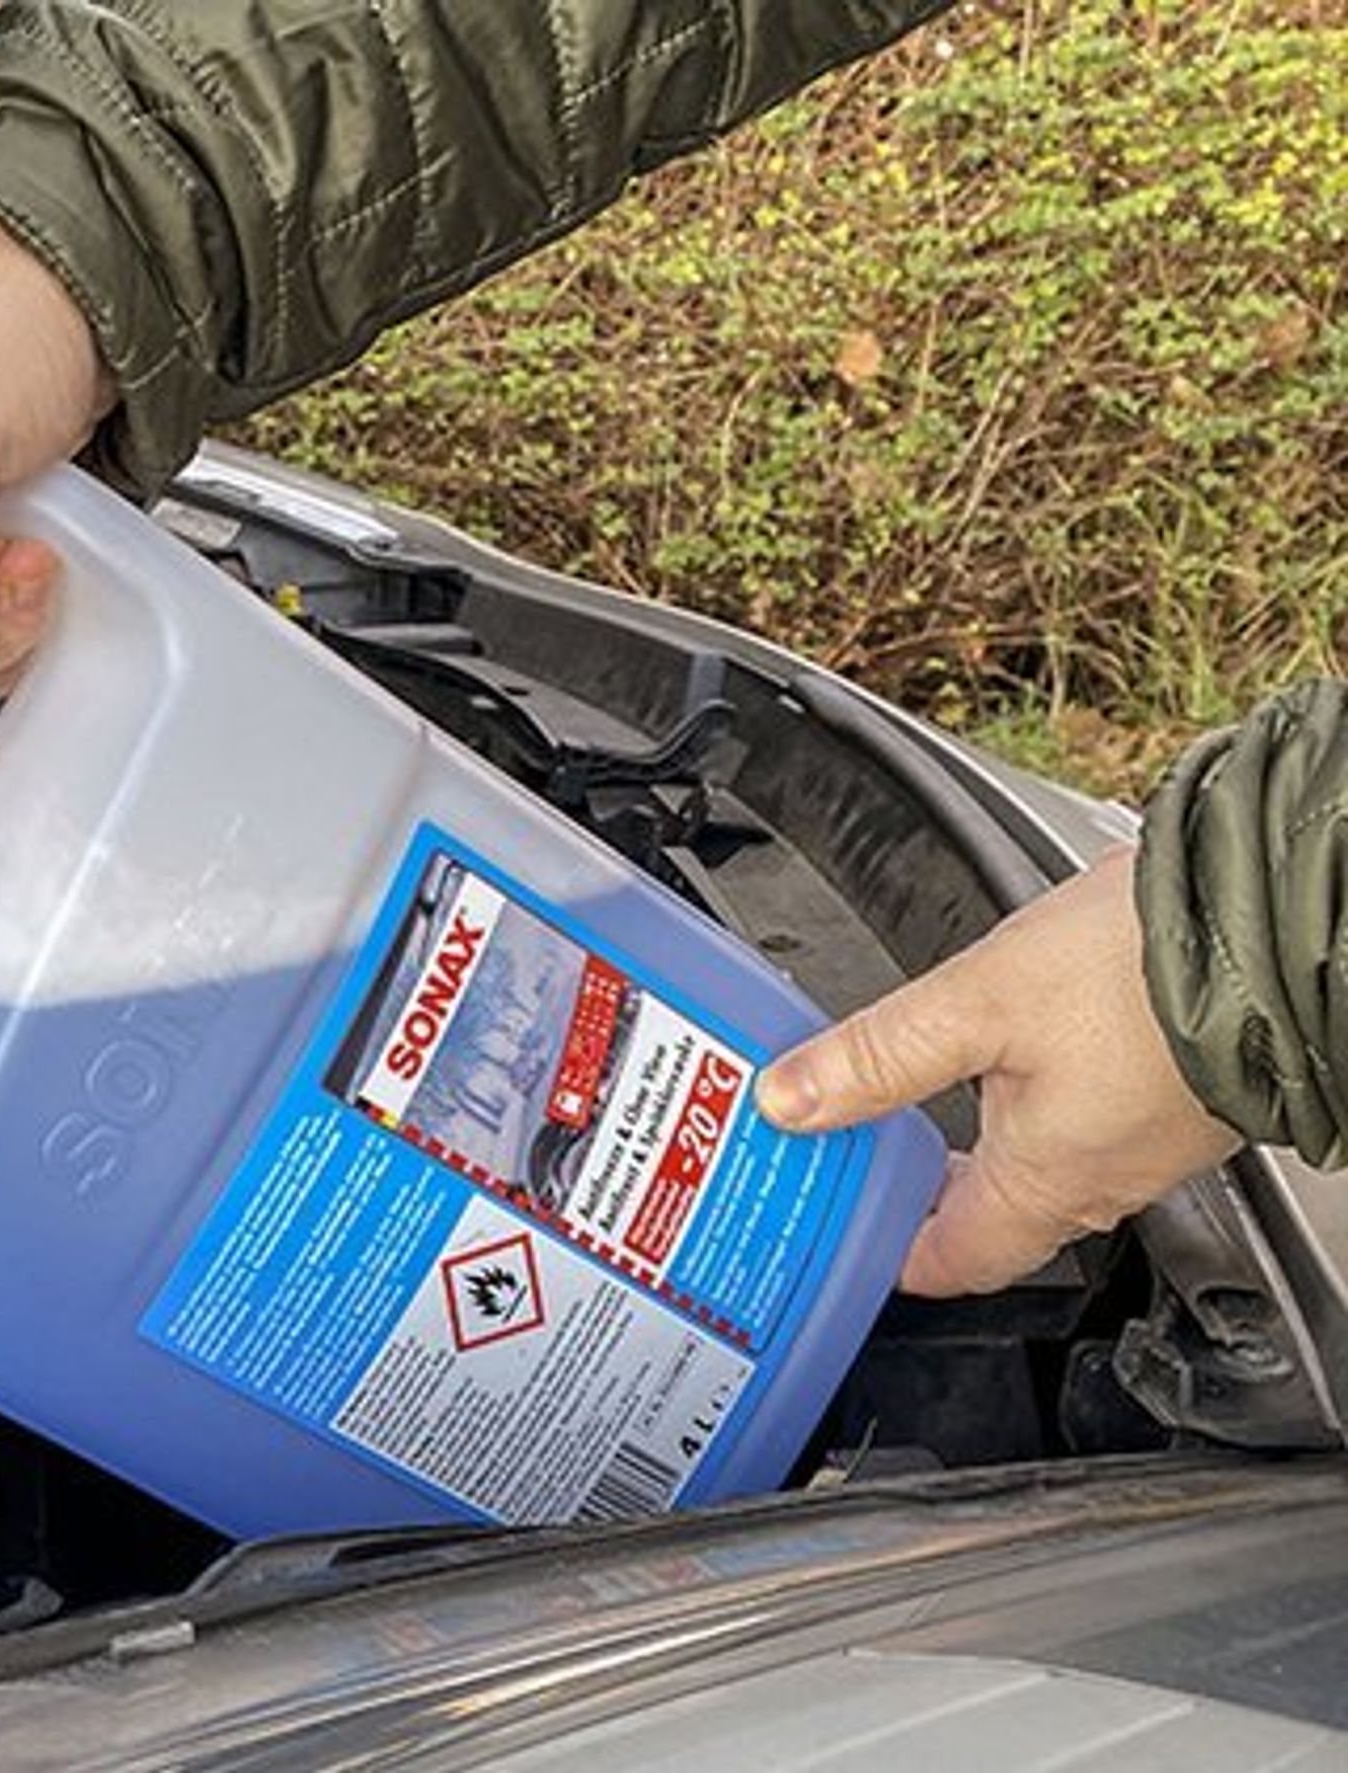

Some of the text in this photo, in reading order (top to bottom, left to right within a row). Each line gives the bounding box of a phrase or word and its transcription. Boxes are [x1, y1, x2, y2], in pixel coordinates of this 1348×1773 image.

[386, 914, 486, 1081] SONAX
[678, 1103, 719, 1173] -20
[680, 1435, 701, 1459] 4
